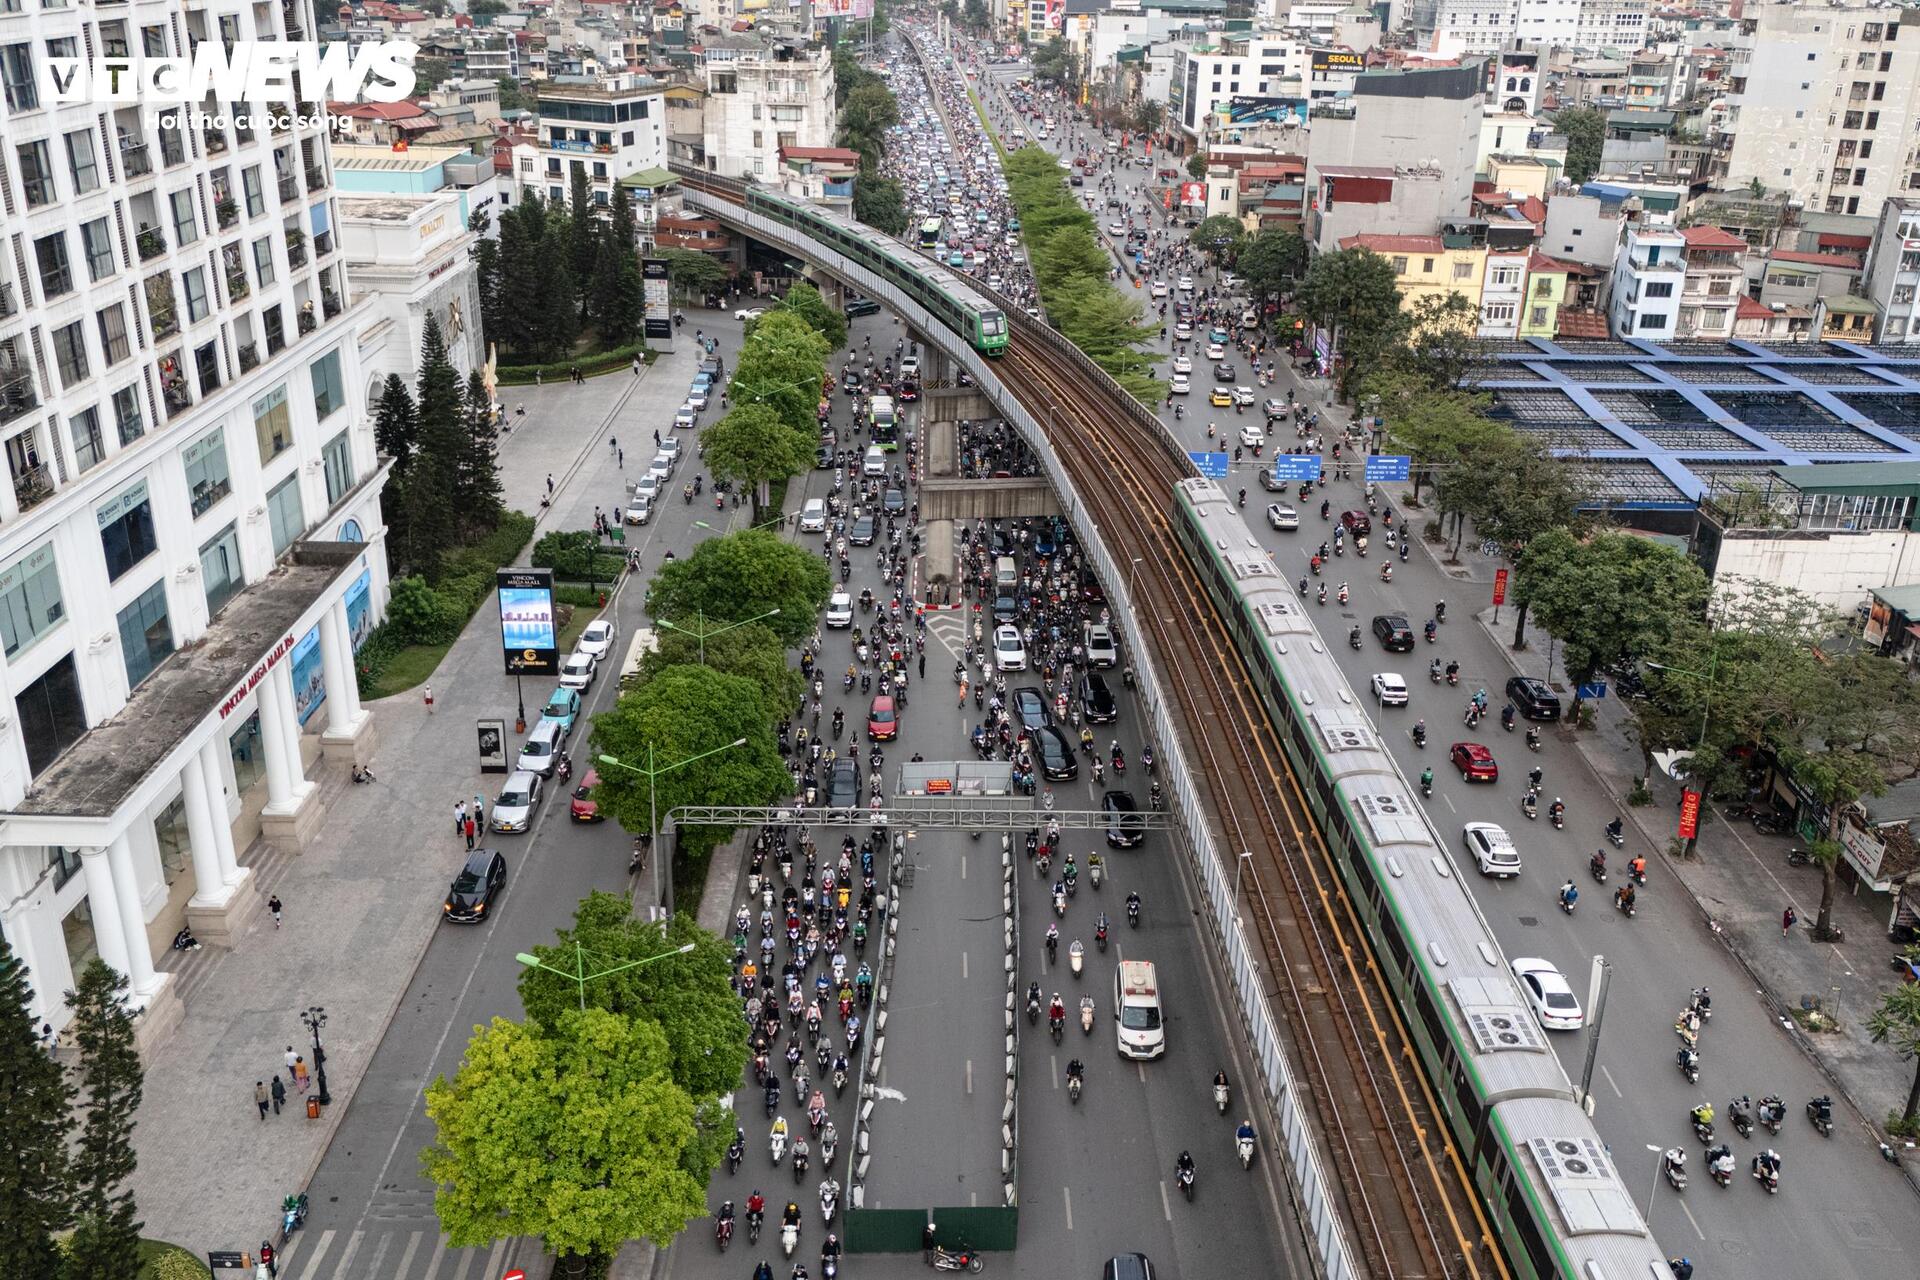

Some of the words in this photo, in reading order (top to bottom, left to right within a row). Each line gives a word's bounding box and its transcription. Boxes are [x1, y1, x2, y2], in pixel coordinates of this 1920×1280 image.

[1328, 55, 1356, 63] SEOUL
[219, 683, 248, 719] VINCOM
[248, 663, 268, 691] MEGA
[267, 643, 286, 670] MALL
[1857, 850, 1872, 866] QUY
